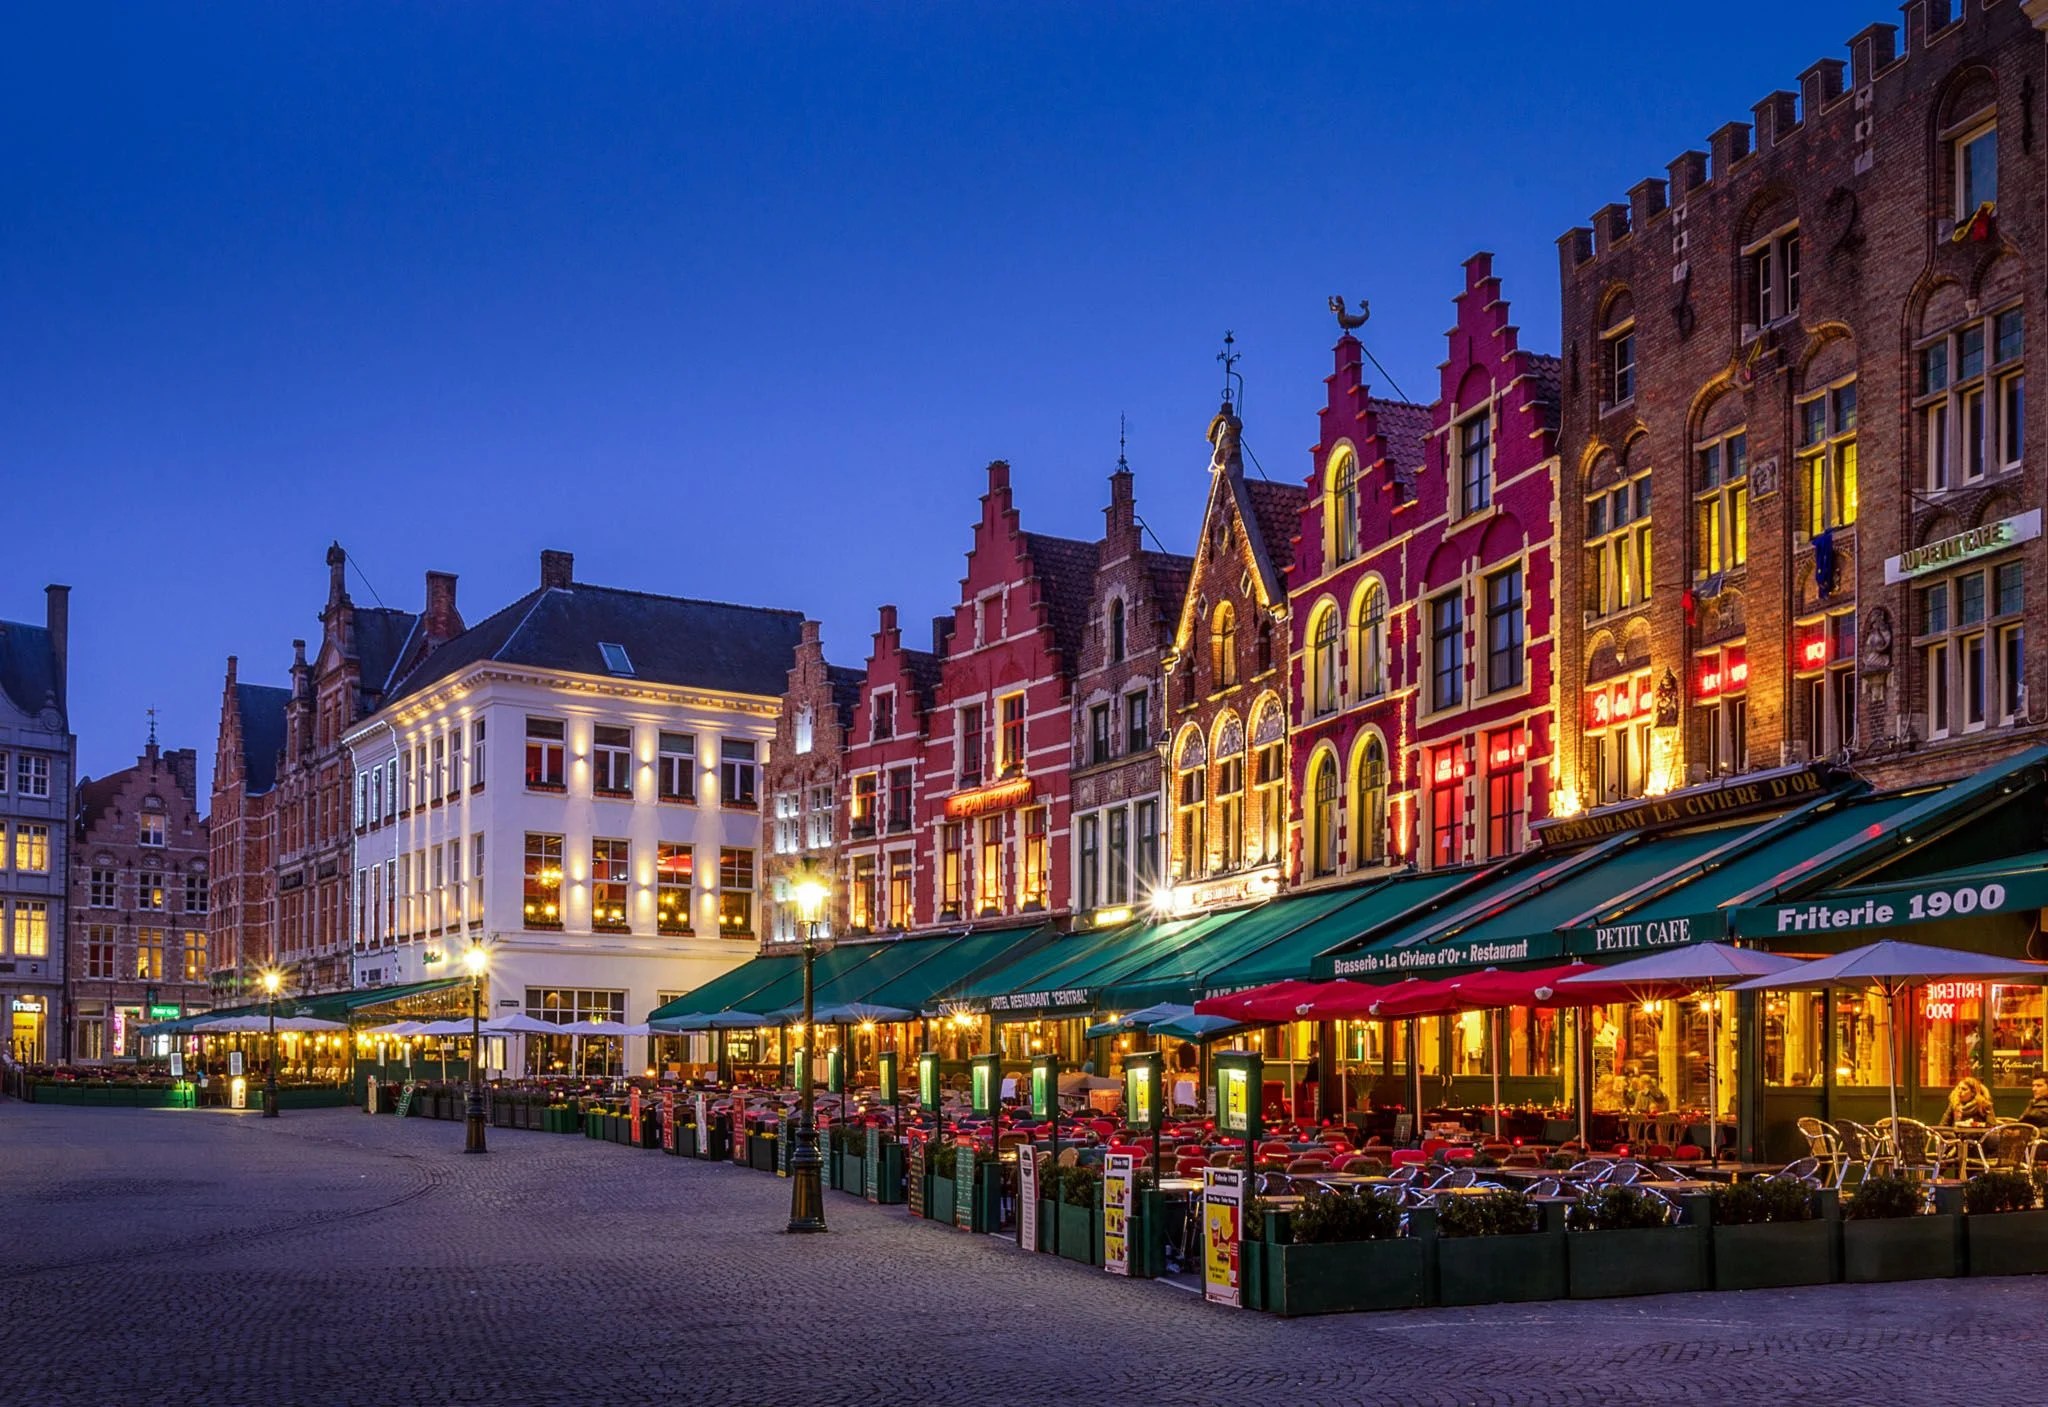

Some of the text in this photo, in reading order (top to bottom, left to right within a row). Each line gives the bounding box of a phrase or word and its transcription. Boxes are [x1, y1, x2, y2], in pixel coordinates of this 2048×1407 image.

[1900, 523, 2000, 572] AU PETIT CAFE
[964, 791, 1003, 816] PANIER
[1544, 771, 1820, 845] RESTAURANT LA CIVIERE D'OR
[1777, 883, 2006, 932] Friterie 1900
[1596, 918, 1691, 951] PETIT CAFE
[1334, 939, 1528, 974] Brasserie La Civiere d'Or Restaurant
[12, 1000, 42, 1012] fnac
[990, 996, 1010, 1010] HOTEL
[1010, 991, 1050, 1009] RESTAURANT
